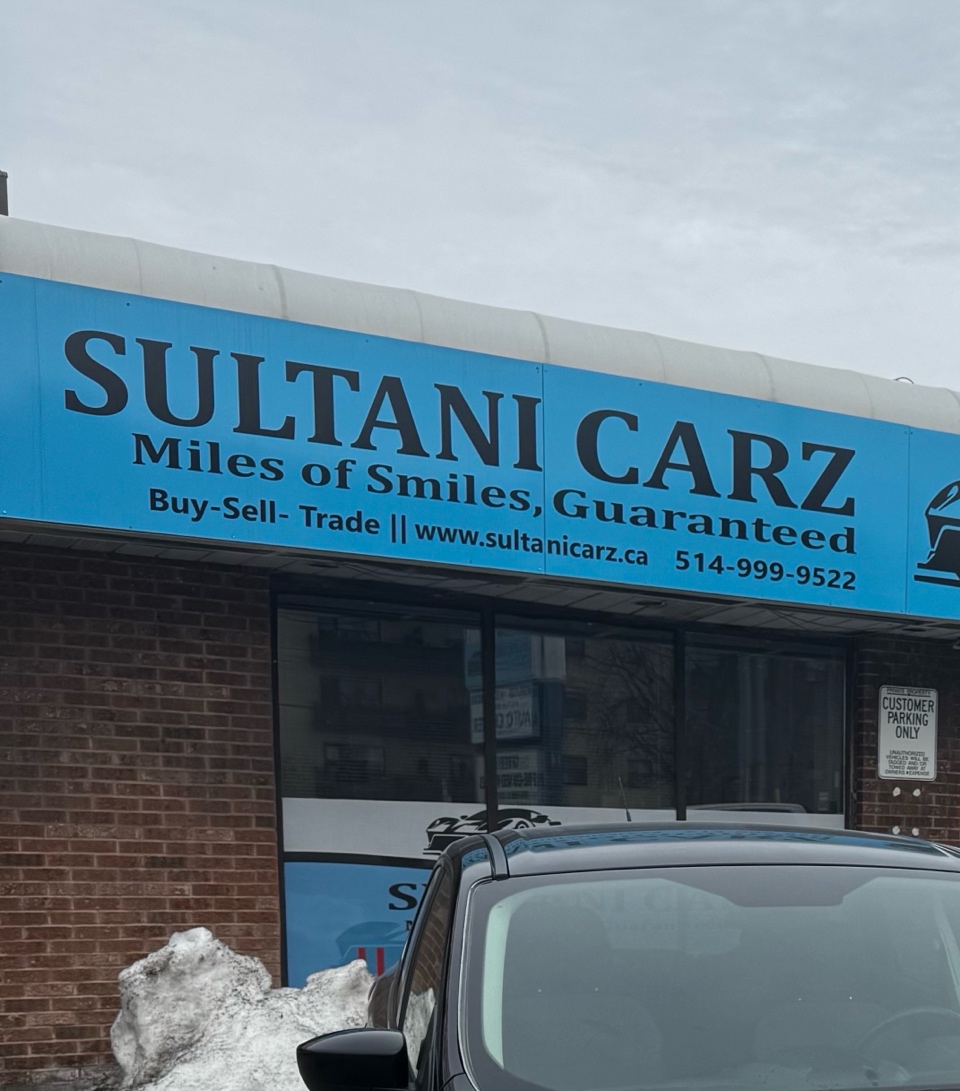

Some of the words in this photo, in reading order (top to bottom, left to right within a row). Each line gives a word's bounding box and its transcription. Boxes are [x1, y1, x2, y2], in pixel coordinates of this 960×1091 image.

[64, 330, 543, 472] SULTANI
[576, 409, 856, 517] CARZ
[132, 433, 284, 481] Miles
[301, 459, 357, 490] of
[367, 464, 543, 518] Smiles,
[553, 489, 856, 555] Guaranteed
[298, 505, 381, 535] Trade
[414, 526, 649, 568] www.sultanicarz.ca
[675, 549, 857, 591] 514-999-9522
[882, 696, 935, 713] CUSTOMER
[887, 711, 928, 727] PARKING
[895, 725, 920, 740] ONLY
